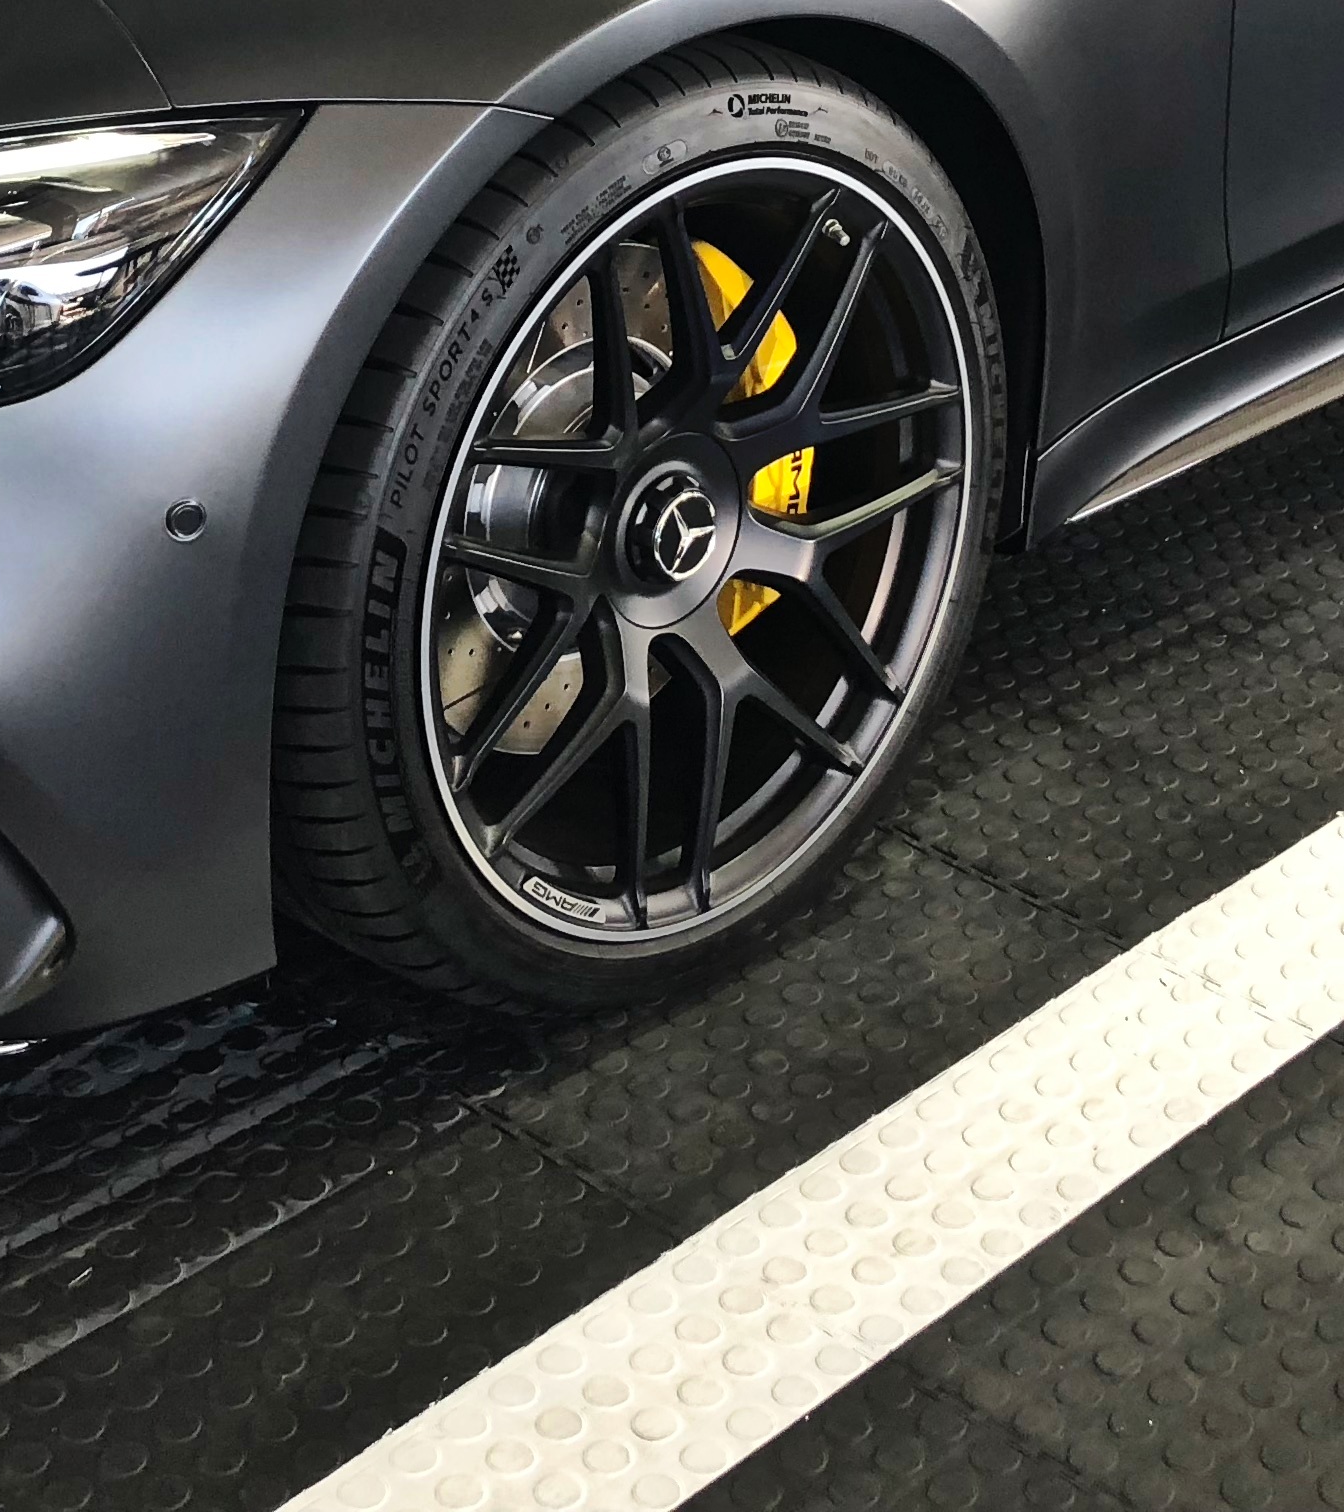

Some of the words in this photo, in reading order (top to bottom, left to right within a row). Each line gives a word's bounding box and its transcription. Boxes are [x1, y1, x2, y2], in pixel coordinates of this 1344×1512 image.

[747, 92, 792, 105] MICHELIN
[389, 423, 426, 510] PILOT
[421, 321, 474, 418] SPORT
[480, 287, 494, 307] S
[364, 547, 414, 835] MICHELIN
[531, 880, 578, 912] AMG
